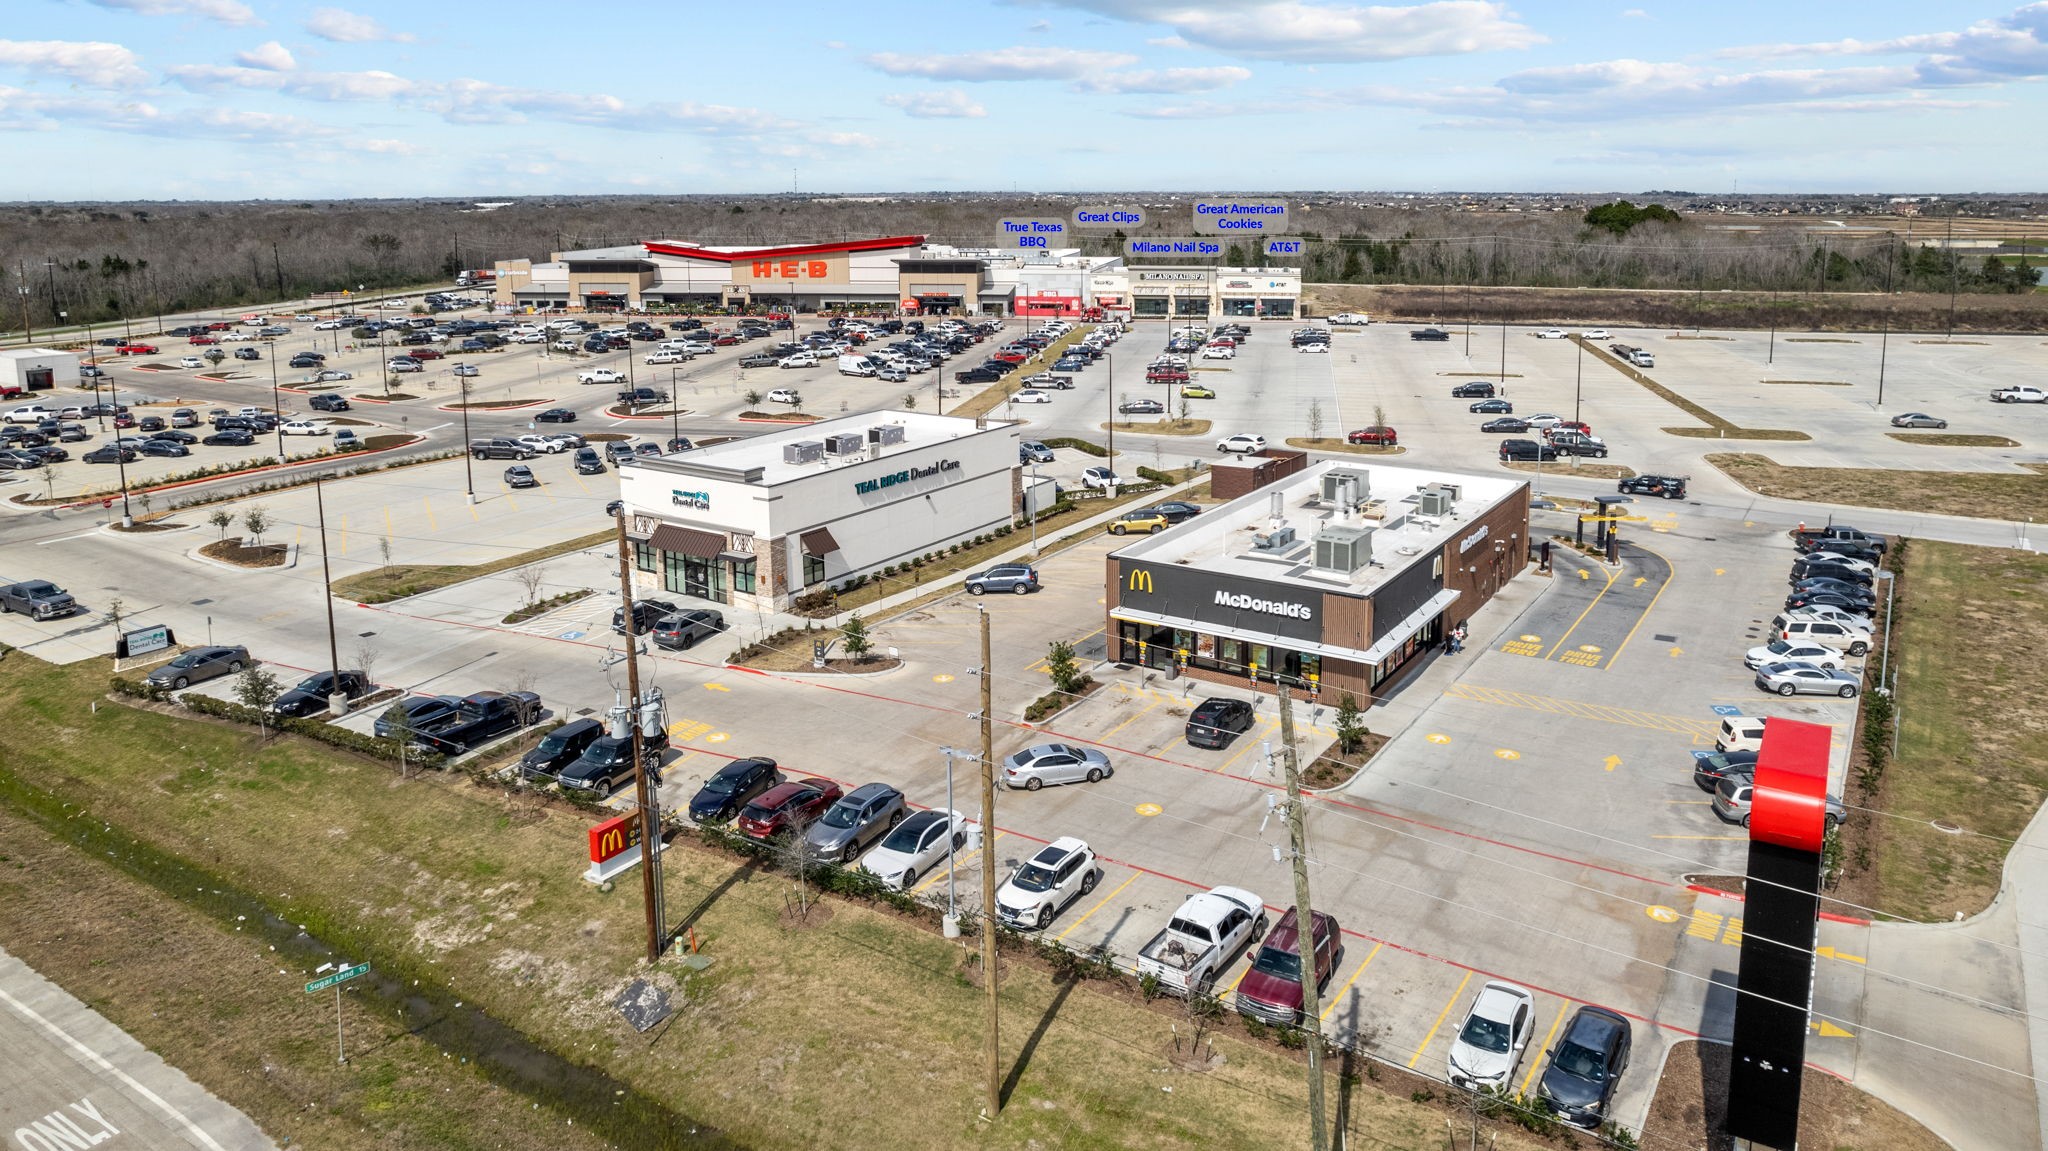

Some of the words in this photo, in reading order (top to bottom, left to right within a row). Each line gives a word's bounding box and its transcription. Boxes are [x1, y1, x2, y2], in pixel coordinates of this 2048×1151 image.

[854, 478, 880, 495] TEAL
[880, 470, 909, 489] RIDGE
[911, 461, 939, 481] Dental
[940, 459, 960, 472] Care
[672, 495, 694, 507] Dental
[694, 499, 710, 511] Care
[1213, 590, 1312, 621] McDonald's
[129, 641, 150, 651] Dental
[1500, 645, 1539, 657] THRU
[1505, 640, 1544, 651] DRIVE
[1559, 655, 1598, 667] THRU
[1563, 649, 1603, 661] DRIVE
[309, 978, 332, 991] Sugar
[335, 969, 354, 982] Land
[14, 1097, 121, 1151] ONLY
